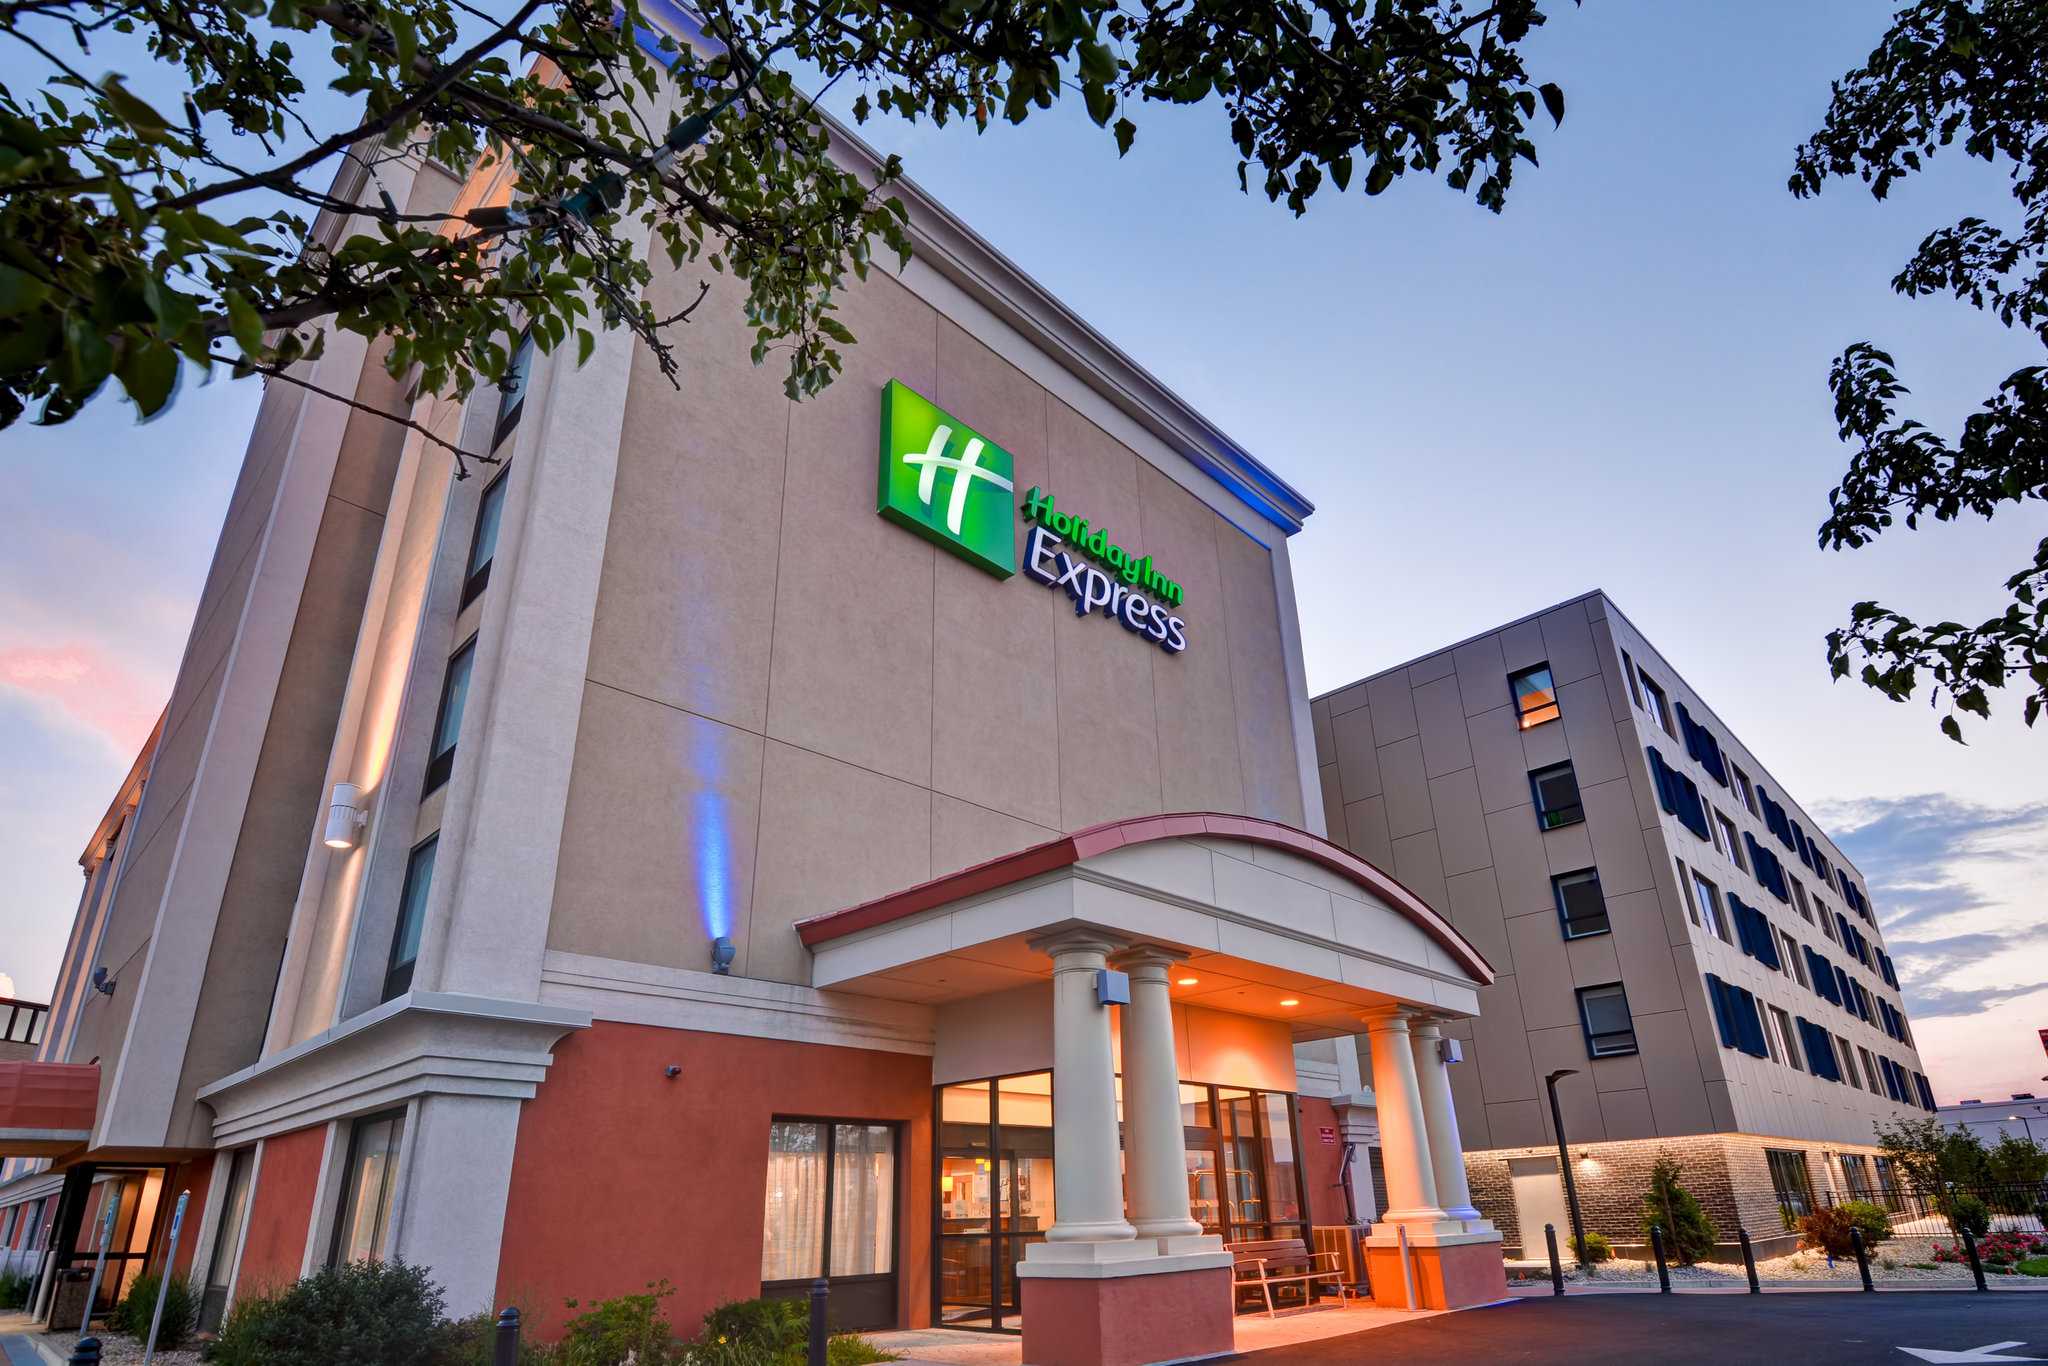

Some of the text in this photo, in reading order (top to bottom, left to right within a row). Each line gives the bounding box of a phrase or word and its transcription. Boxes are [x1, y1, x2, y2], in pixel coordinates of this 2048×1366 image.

[1023, 486, 1184, 608] Holiday Inn
[1023, 525, 1187, 653] Express
